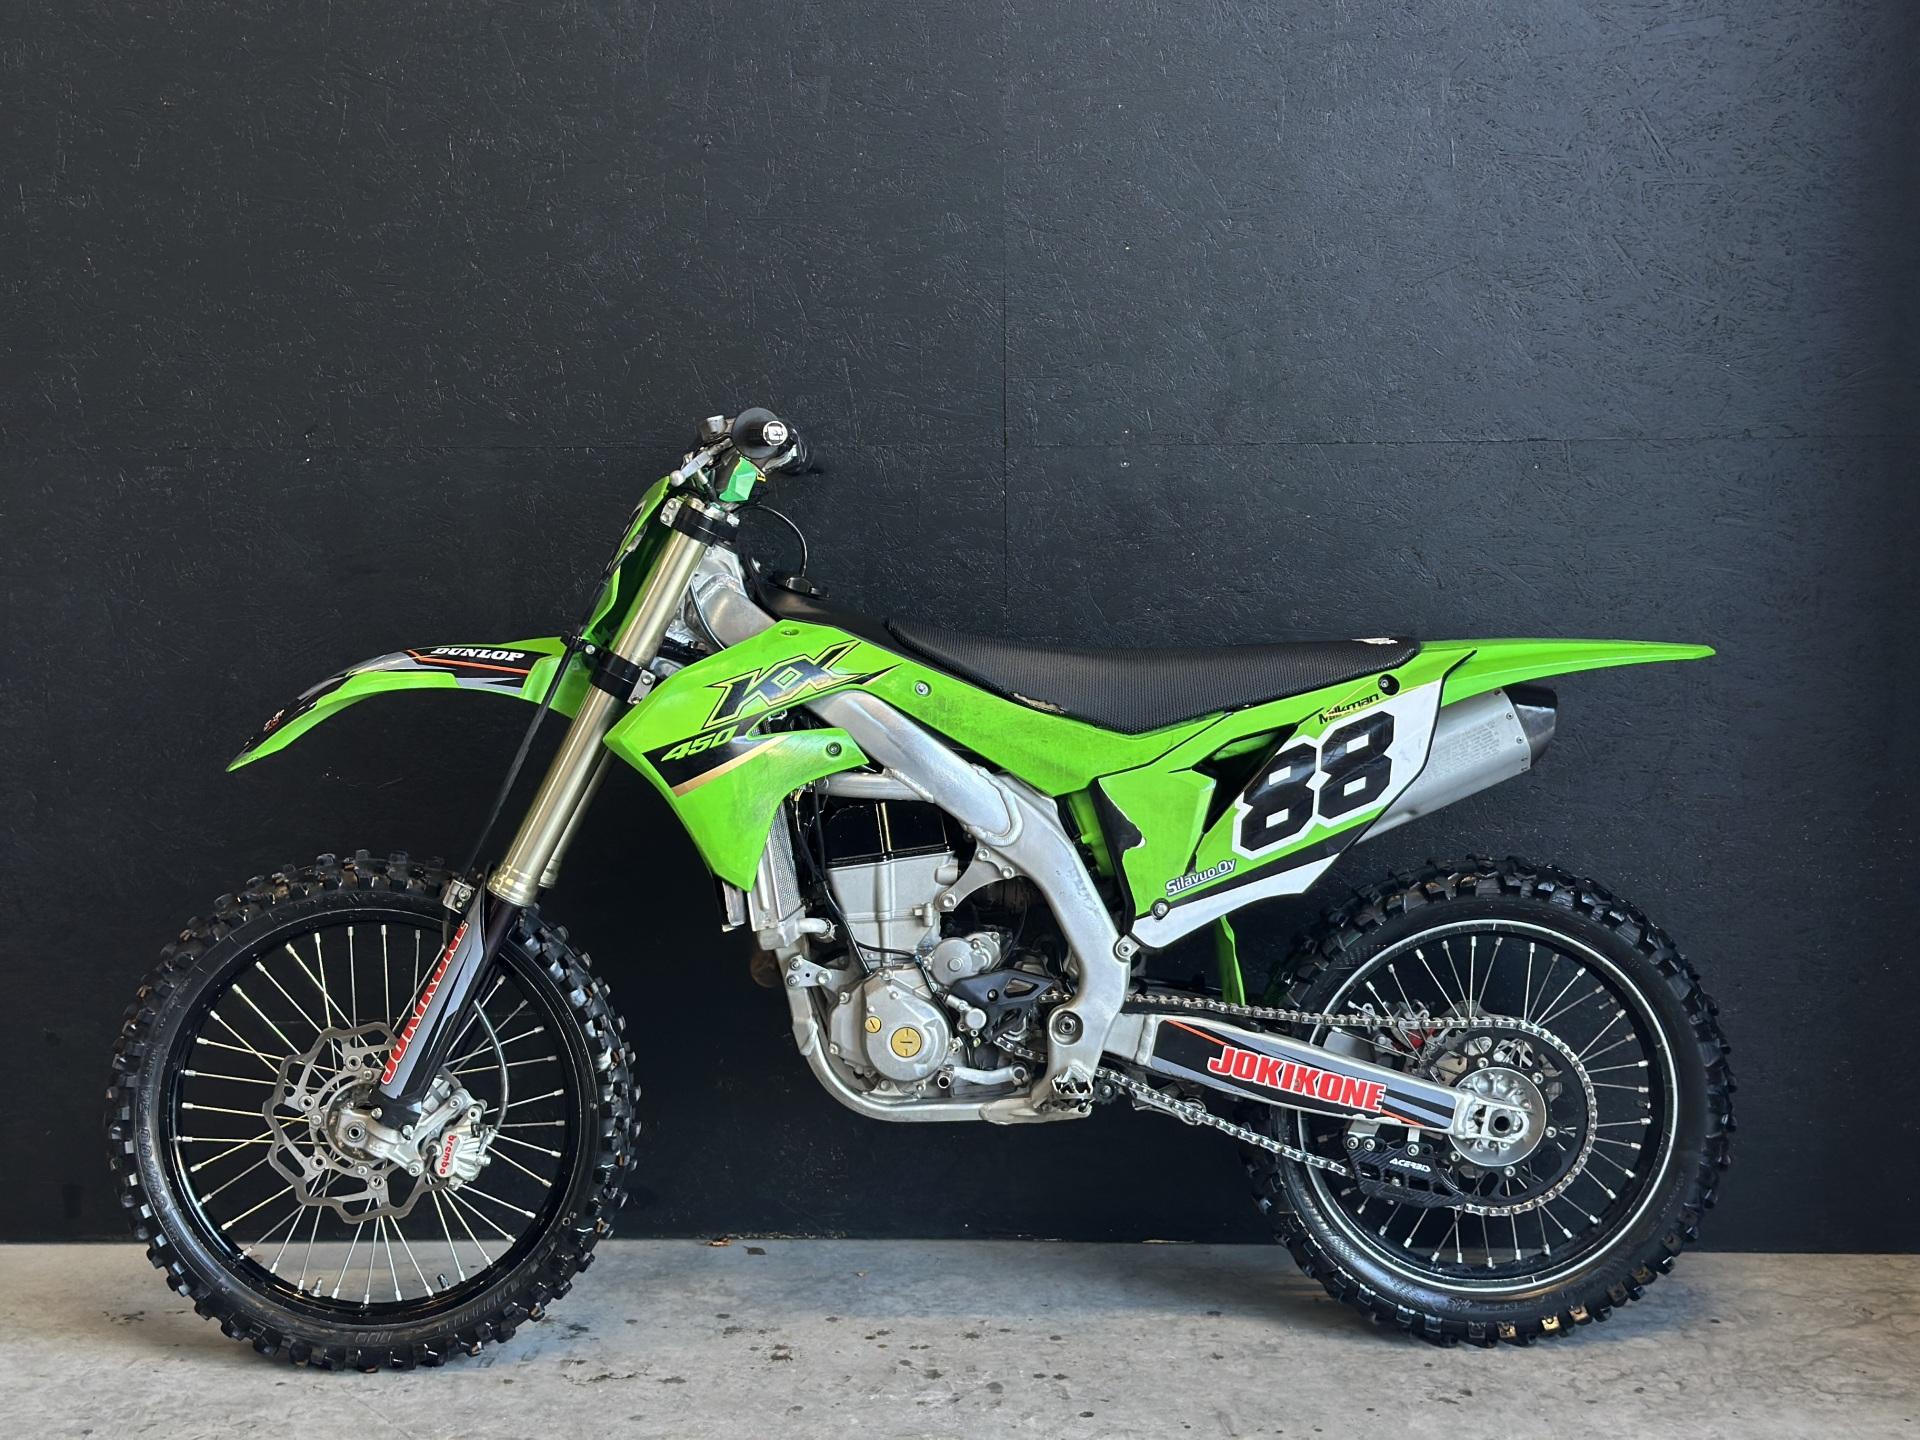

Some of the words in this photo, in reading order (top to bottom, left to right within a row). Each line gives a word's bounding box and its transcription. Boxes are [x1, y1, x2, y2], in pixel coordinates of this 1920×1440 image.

[430, 647, 525, 662] DUNLOP
[703, 639, 869, 730] KX
[660, 726, 738, 762] 450
[1239, 710, 1395, 852] 88
[1165, 867, 1216, 893] Silavuo
[1217, 859, 1236, 874] Oy
[1207, 1044, 1386, 1114] JOKIKONE
[439, 1134, 457, 1175] brembo
